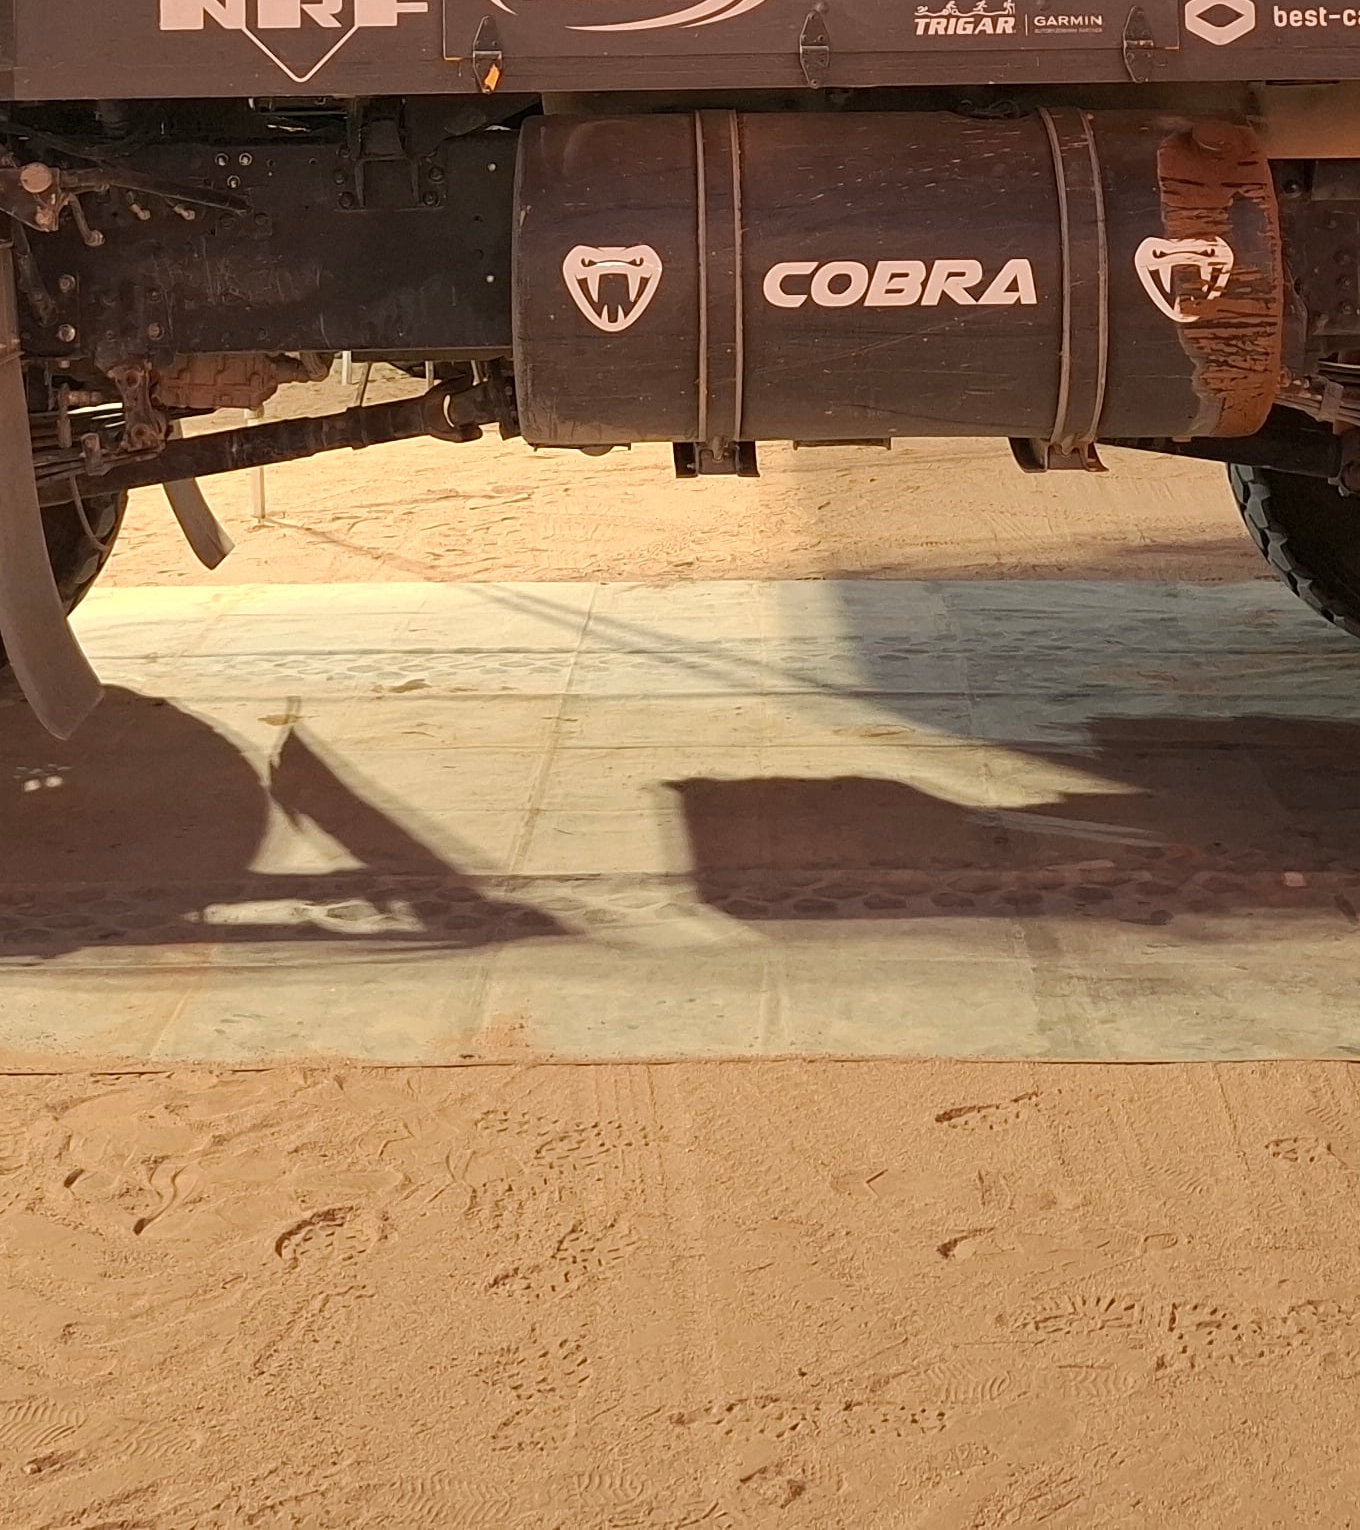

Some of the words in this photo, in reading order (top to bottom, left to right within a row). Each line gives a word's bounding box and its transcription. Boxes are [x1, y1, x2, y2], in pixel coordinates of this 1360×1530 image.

[914, 17, 1016, 36] TRIGAR
[1034, 15, 1103, 26] GARMIN
[762, 258, 1038, 307] COBRA
